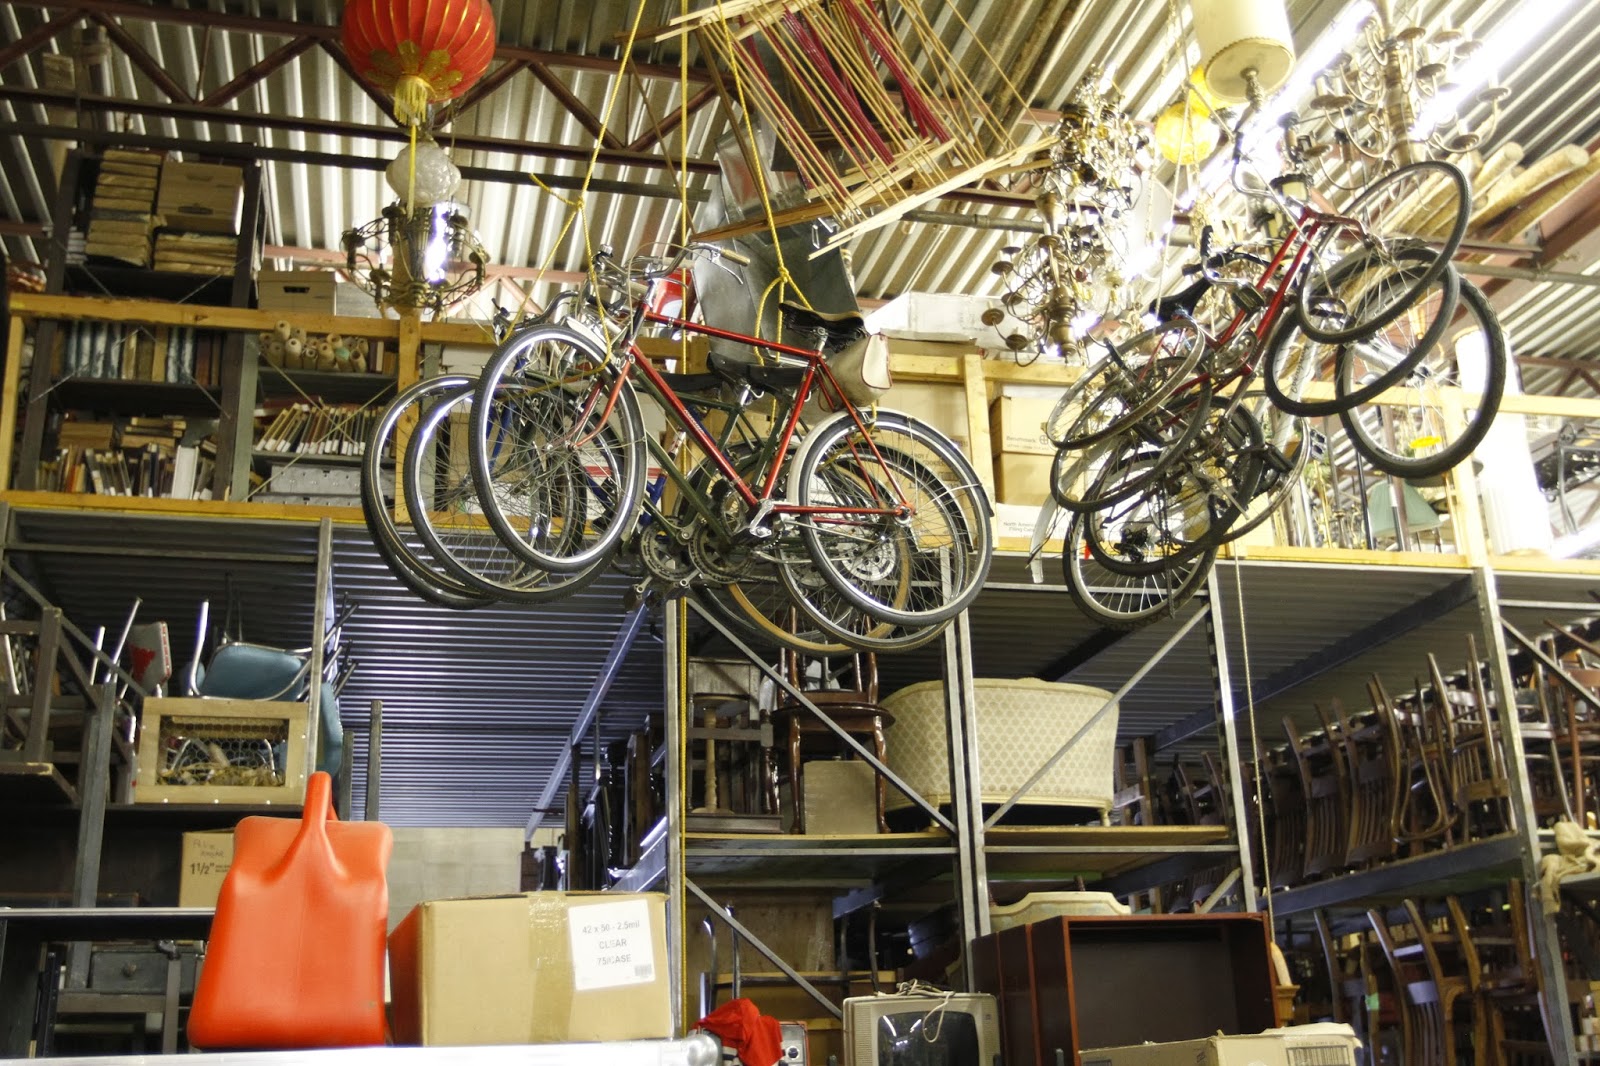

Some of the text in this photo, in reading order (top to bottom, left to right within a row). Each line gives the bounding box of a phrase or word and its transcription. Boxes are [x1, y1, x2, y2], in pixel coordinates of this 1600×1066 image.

[582, 925, 592, 934] 42
[601, 923, 610, 932] 50
[599, 938, 627, 949] CLEAR
